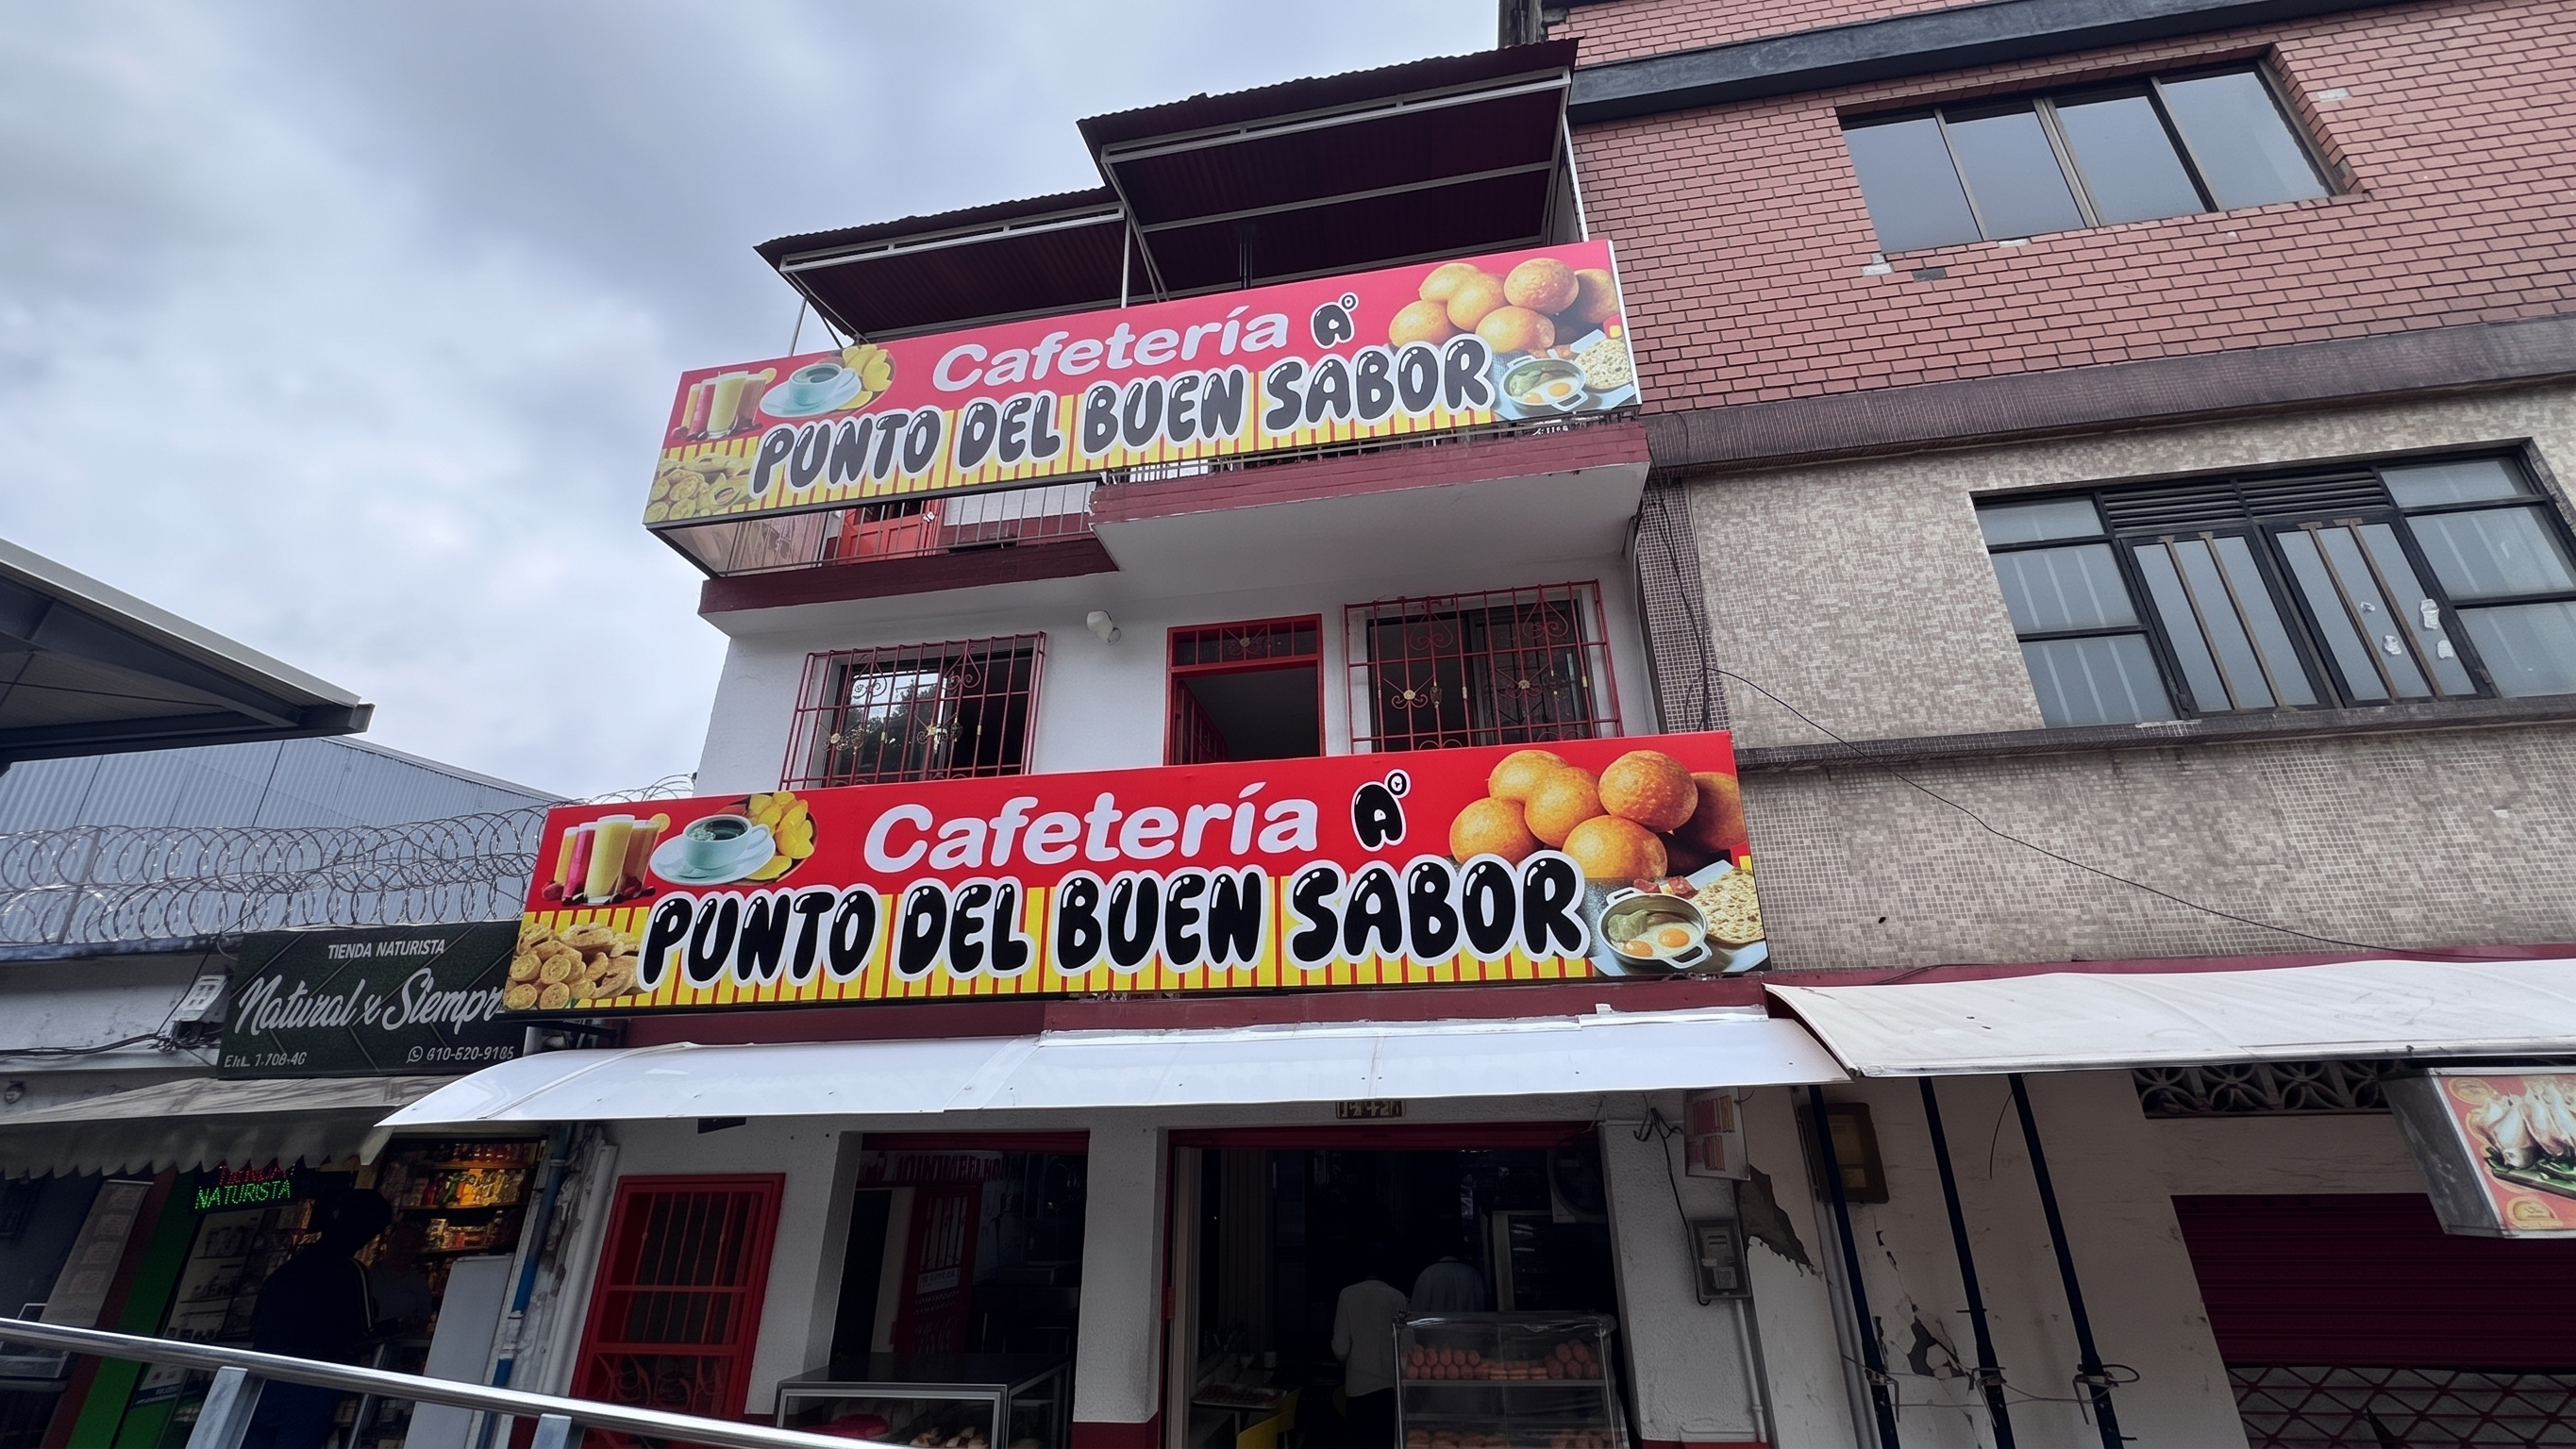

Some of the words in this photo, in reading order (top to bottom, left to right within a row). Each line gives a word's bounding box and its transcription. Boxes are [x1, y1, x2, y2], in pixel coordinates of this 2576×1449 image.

[932, 305, 1289, 392] Cafetería
[749, 404, 945, 499] PUNTO
[954, 390, 1066, 472] DEL
[1079, 364, 1251, 459] BUEN
[1263, 333, 1496, 435] SABOR
[863, 782, 1318, 874] Cafetería
[327, 943, 373, 959] TIENDA
[376, 939, 445, 957] NATURISTA
[637, 880, 882, 992] PUNTO
[893, 875, 1035, 982] DEL
[1049, 863, 1270, 977] BUEN
[1285, 849, 1592, 971] SABOR
[234, 974, 366, 1036] Natural
[381, 967, 504, 1035] Siempr
[194, 1179, 291, 1209] NATURISTA
